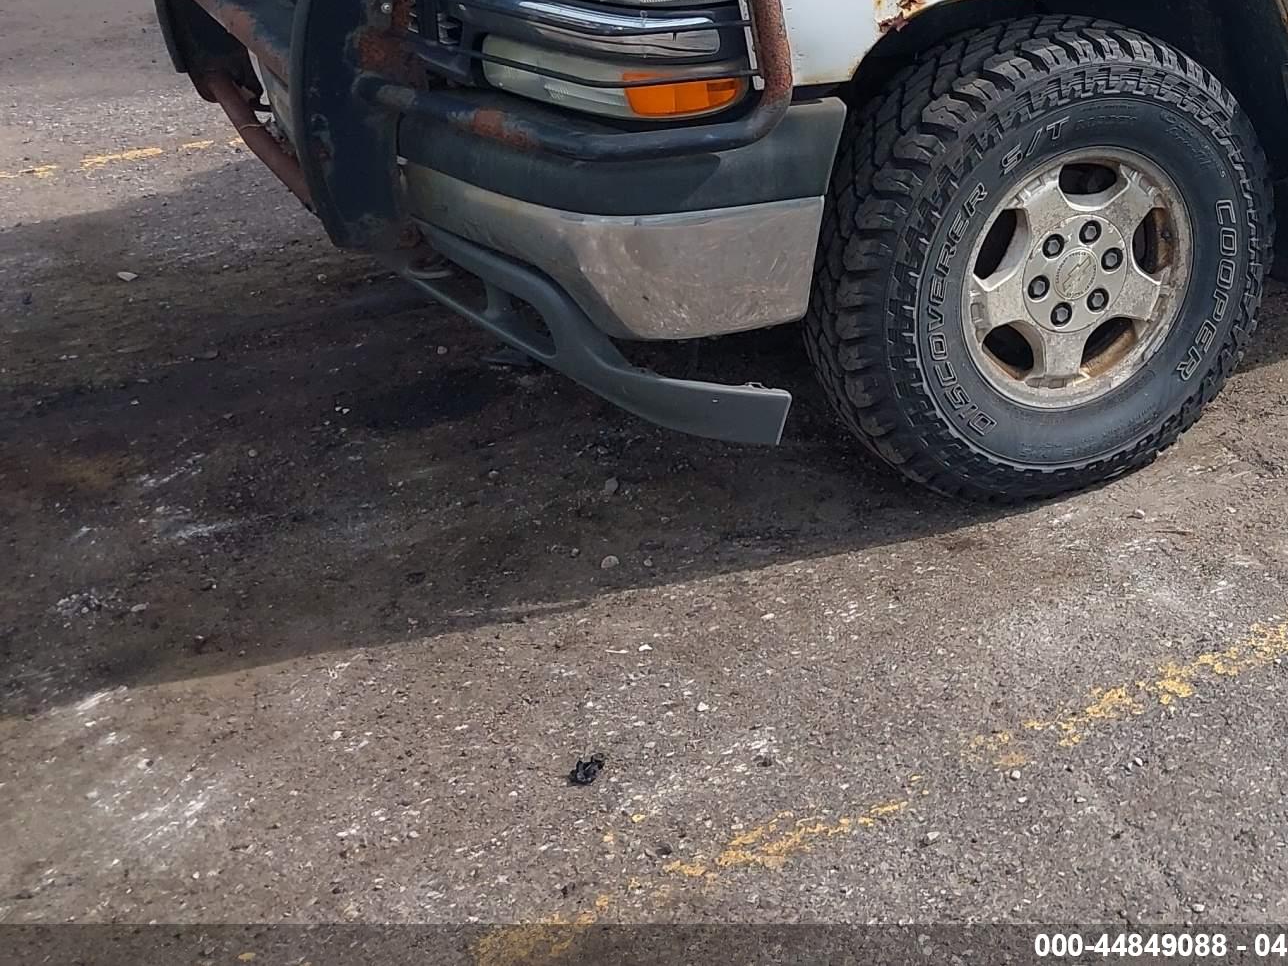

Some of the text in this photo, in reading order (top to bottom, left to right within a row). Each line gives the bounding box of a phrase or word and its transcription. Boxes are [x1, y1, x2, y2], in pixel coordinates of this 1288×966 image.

[927, 116, 1070, 436] DISCOVERER S/T
[1176, 199, 1238, 381] COOPER
